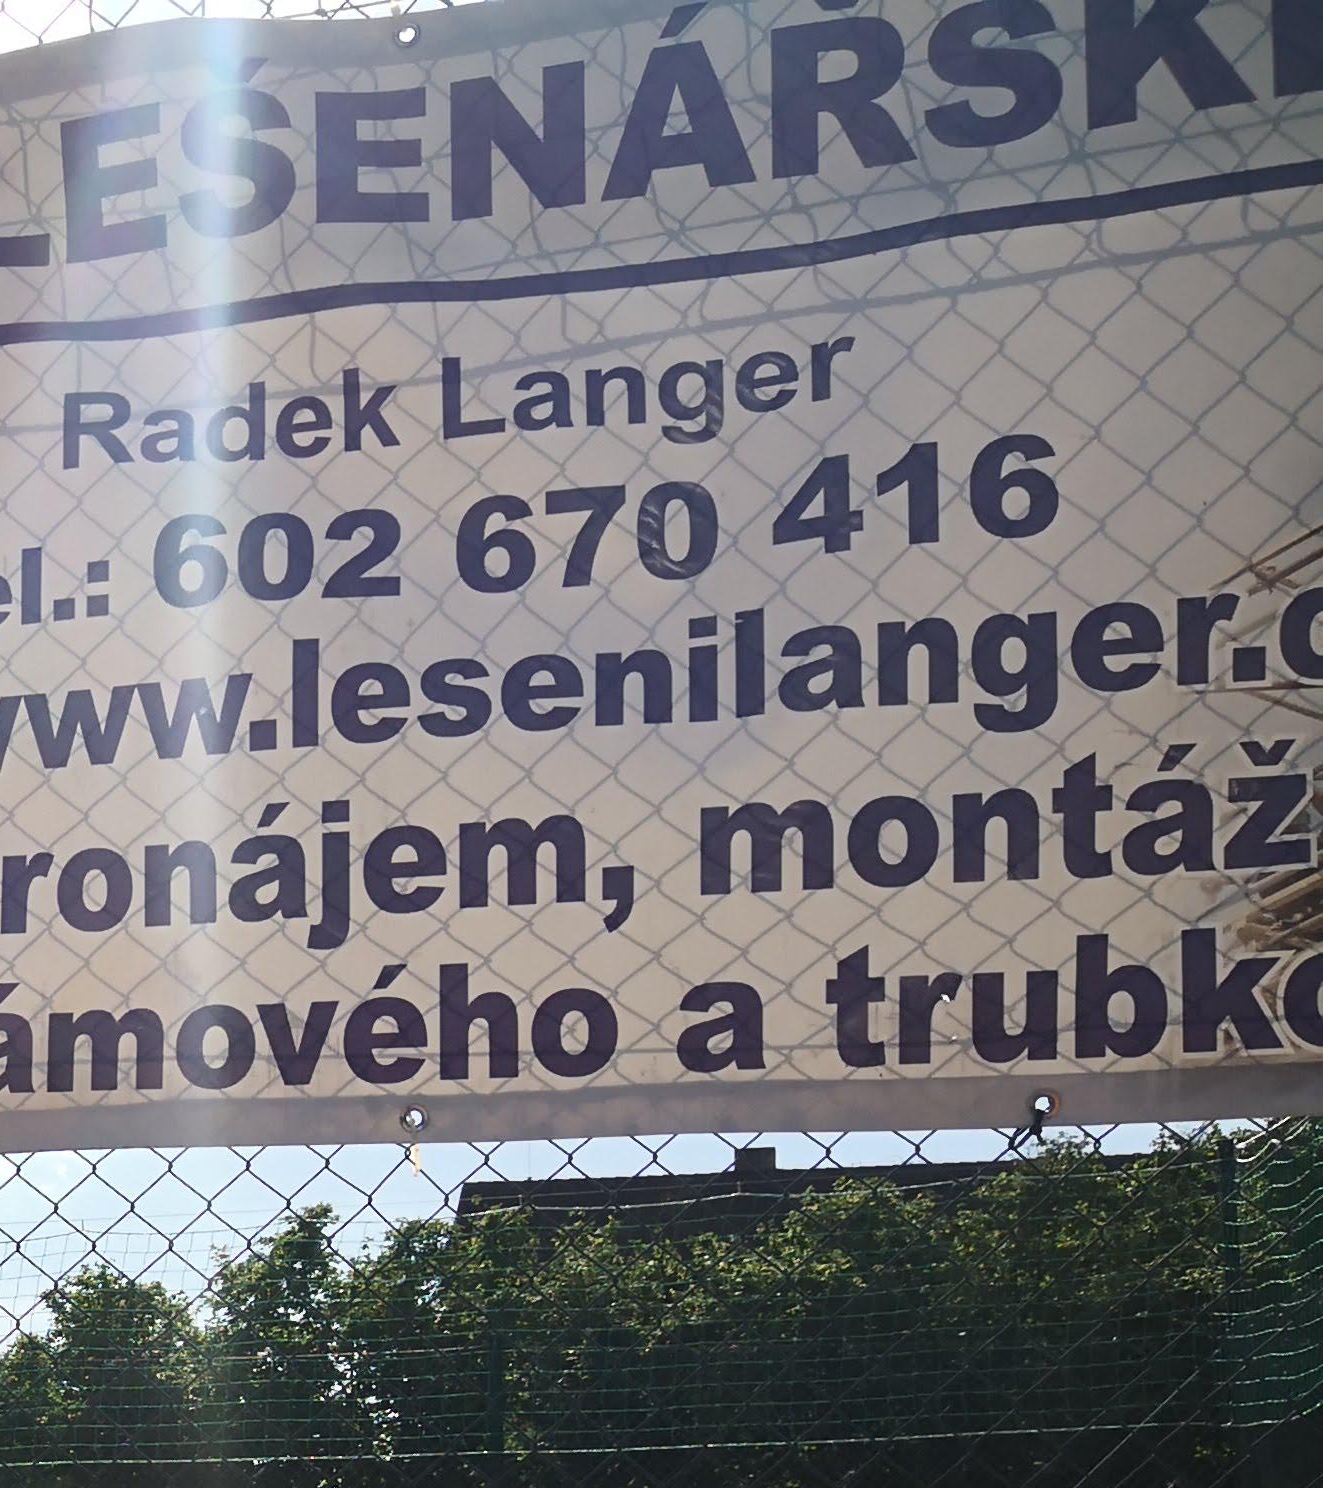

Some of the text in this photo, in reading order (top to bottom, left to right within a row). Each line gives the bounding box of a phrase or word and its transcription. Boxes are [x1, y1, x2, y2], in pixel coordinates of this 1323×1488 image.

[63, 336, 854, 469] Radek Langer
[153, 508, 401, 608] 602
[456, 481, 718, 593] 670
[772, 433, 1059, 554] 416
[700, 739, 1314, 896] montáž
[677, 981, 766, 1072] a
